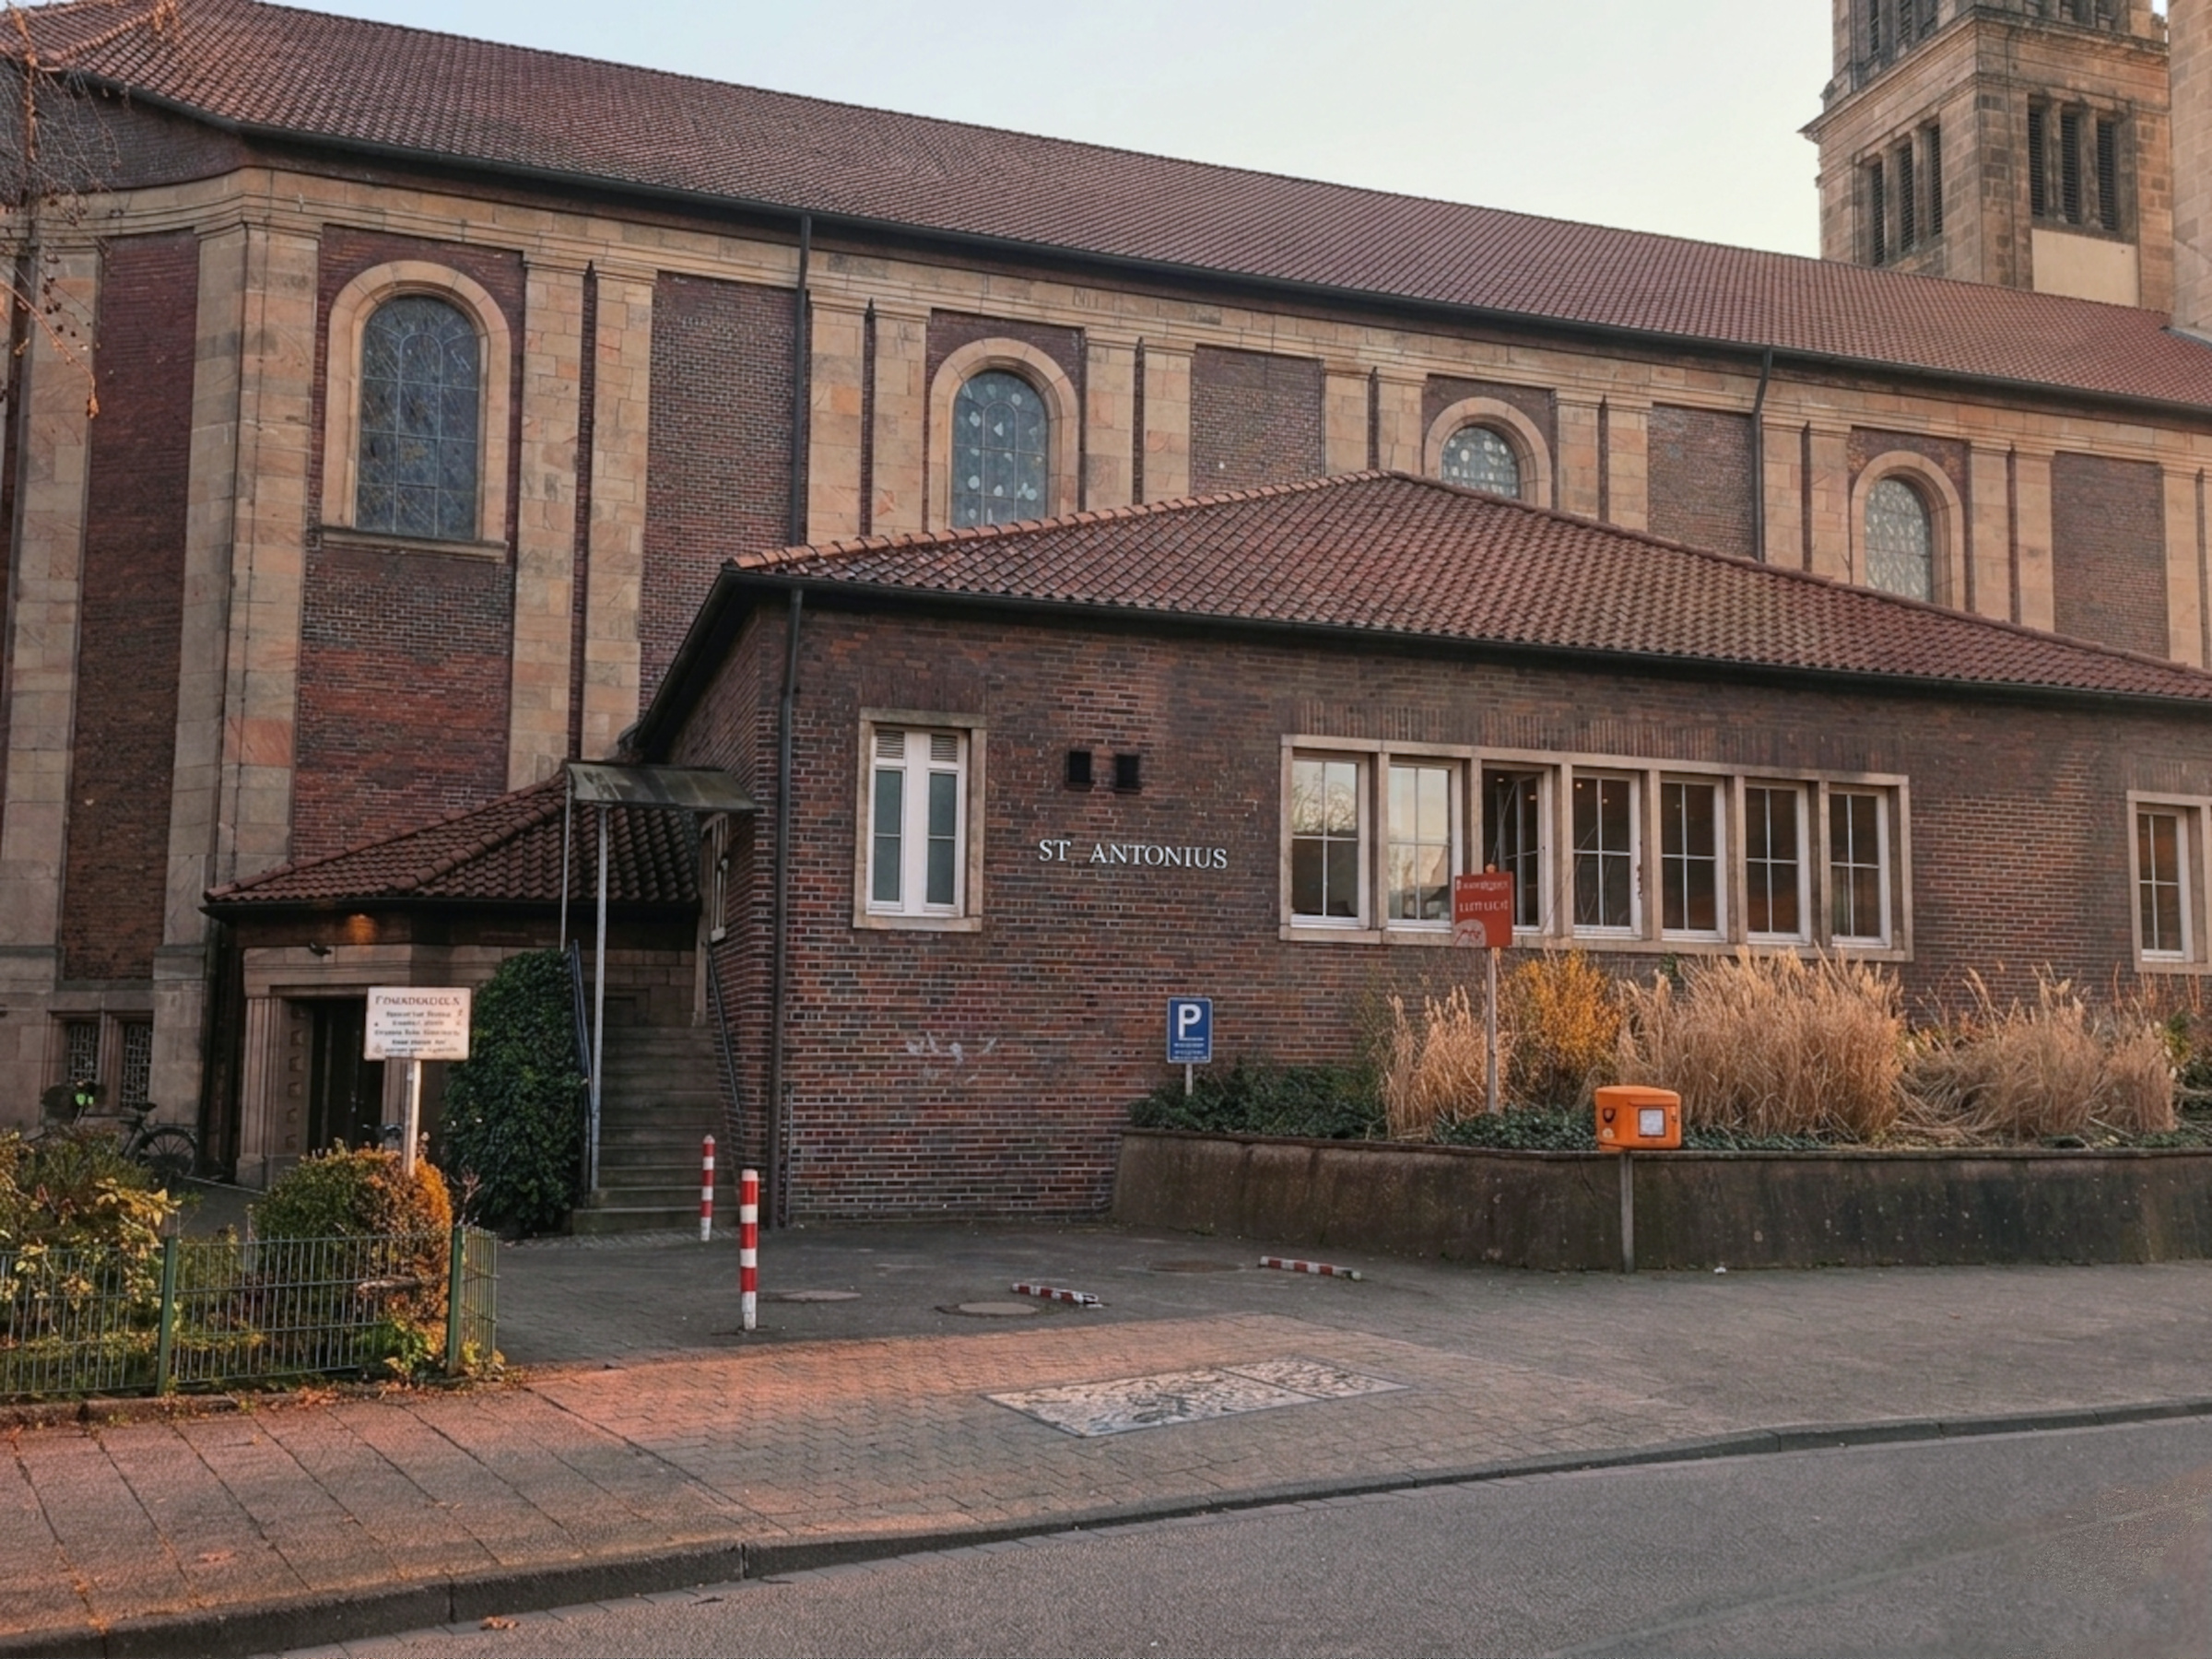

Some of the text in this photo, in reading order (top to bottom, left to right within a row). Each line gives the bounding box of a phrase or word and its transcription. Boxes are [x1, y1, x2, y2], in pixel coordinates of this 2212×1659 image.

[1038, 839, 1228, 869] ST ANTONIUS
[1178, 1003, 1202, 1039] P
